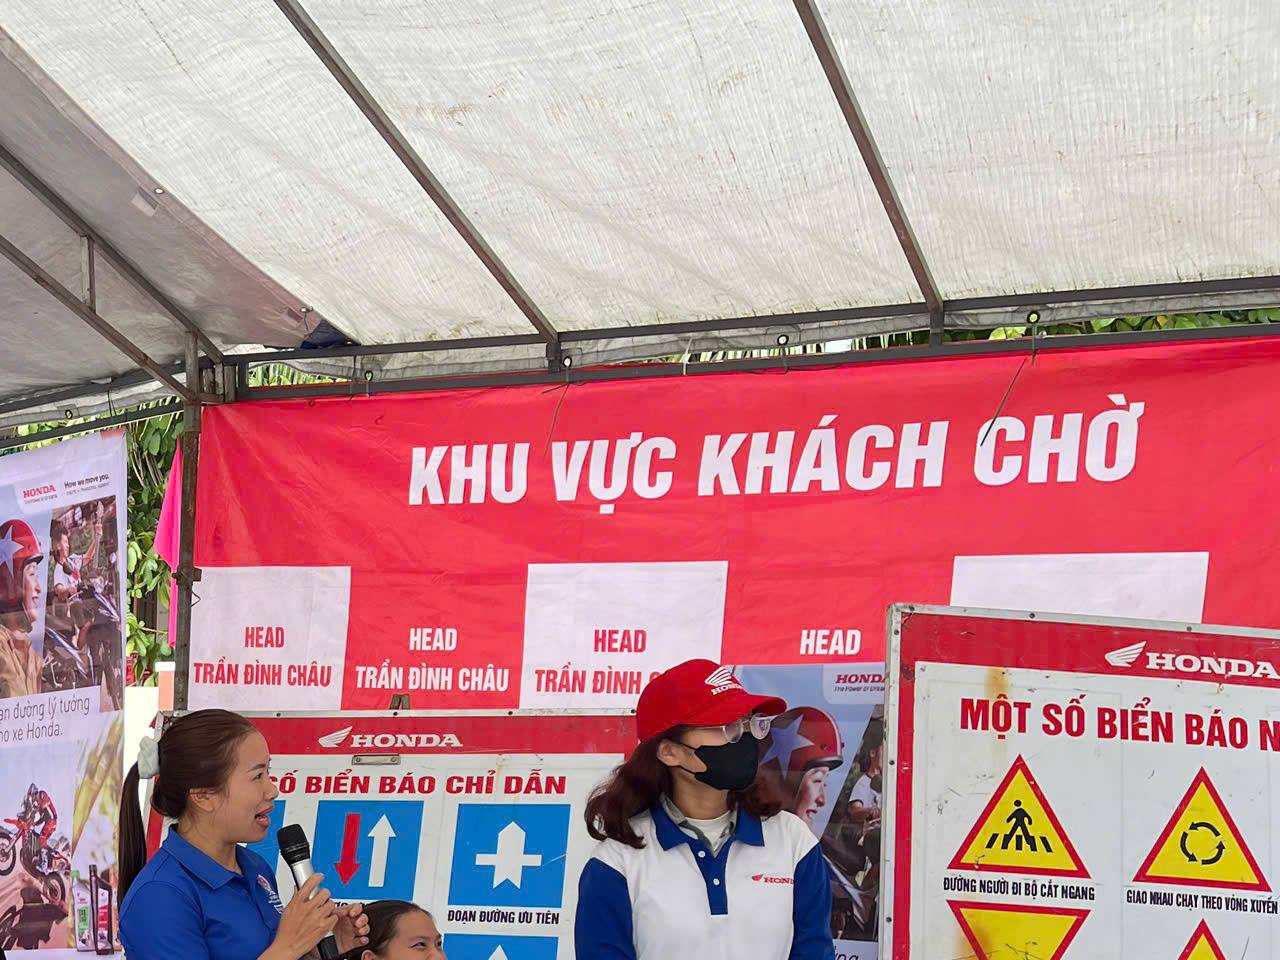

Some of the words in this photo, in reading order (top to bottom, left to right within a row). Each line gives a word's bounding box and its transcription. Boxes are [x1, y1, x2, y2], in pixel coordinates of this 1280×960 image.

[408, 442, 531, 506] KHU
[552, 431, 676, 514] VỰC
[697, 414, 950, 498] KHÁCH
[974, 393, 1146, 487] CHỜ
[23, 484, 57, 498] HONDA
[244, 626, 285, 649] HEAD
[409, 627, 458, 651] HEAD
[593, 629, 647, 653] HEAD
[799, 628, 862, 656] HEAD
[194, 659, 239, 686] TRẦN
[243, 660, 282, 686] ĐÌNH
[286, 660, 331, 687] CHÂU
[355, 658, 404, 690] TRẦN
[408, 660, 454, 691] ĐÌNH
[458, 662, 509, 693] CHÂU
[535, 662, 586, 694] TRẦN
[592, 665, 641, 694] ĐÌNH
[1146, 652, 1280, 681] HONDA
[13, 700, 45, 721] đường
[48, 696, 57, 719] lý
[59, 693, 90, 716] tưởng
[12, 727, 24, 741] xe
[27, 722, 63, 740] Honda.
[960, 693, 1032, 740] MỘT
[1042, 694, 1088, 738] SỐ
[1097, 697, 1174, 744] BIỂN
[1185, 709, 1248, 749] BÁO
[350, 733, 463, 748] HONDA
[305, 768, 370, 794] BIỂN
[378, 769, 436, 794] BÁO
[445, 769, 497, 794] CHỈ
[504, 769, 567, 795] DẪN
[944, 875, 977, 893] ĐƯỜNG
[979, 877, 1009, 895] NGƯỜI
[1012, 883, 1022, 896] ĐI
[1025, 880, 1038, 900] BỘ
[1040, 878, 1059, 898] CẮT
[1061, 886, 1095, 901] NGANG
[1126, 890, 1147, 905] GIAO
[1150, 892, 1174, 906] NHAU
[1176, 893, 1199, 911] CHẠY
[1201, 895, 1221, 910] THEO
[448, 910, 476, 923] ĐOẠN
[479, 908, 516, 924] ĐƯỜNG
[518, 911, 534, 925] ƯU
[535, 910, 560, 925] TIÊN
